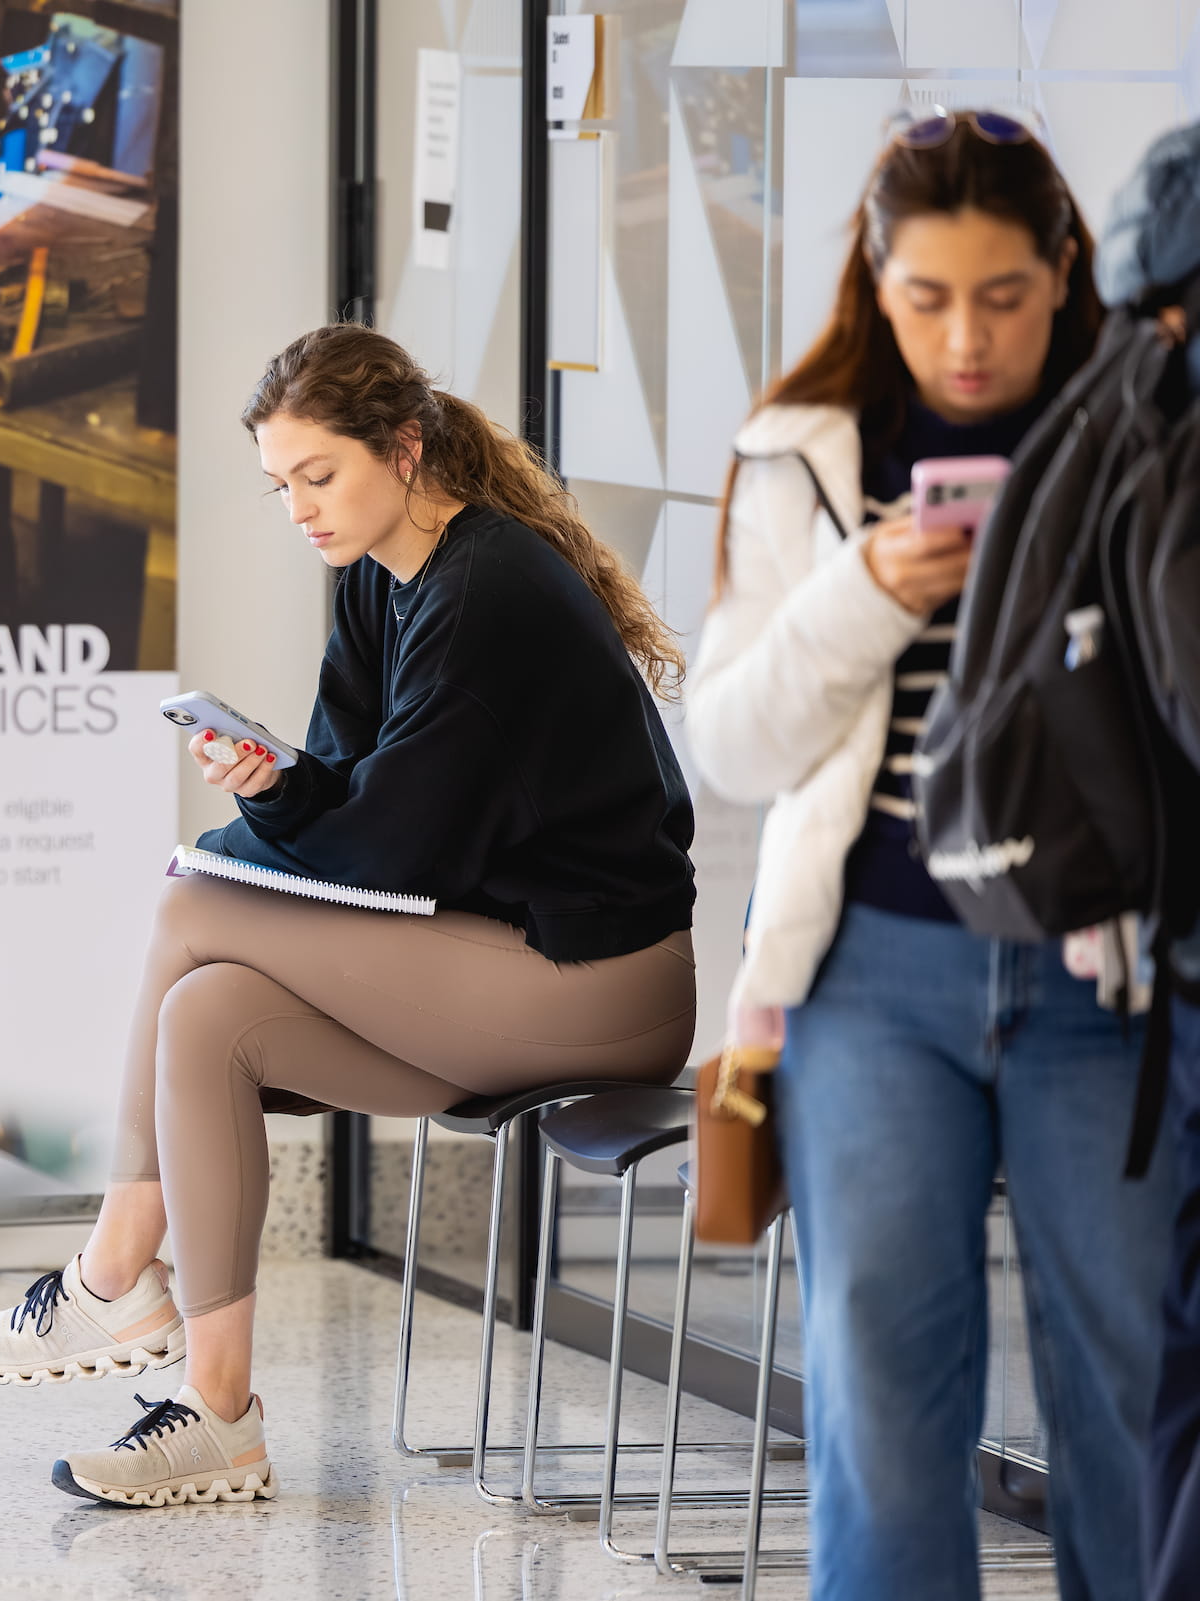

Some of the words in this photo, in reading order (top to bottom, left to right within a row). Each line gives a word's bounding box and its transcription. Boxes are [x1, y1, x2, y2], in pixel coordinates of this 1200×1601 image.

[4, 799, 74, 823] eligible
[16, 832, 97, 857] request
[13, 864, 62, 886] start
